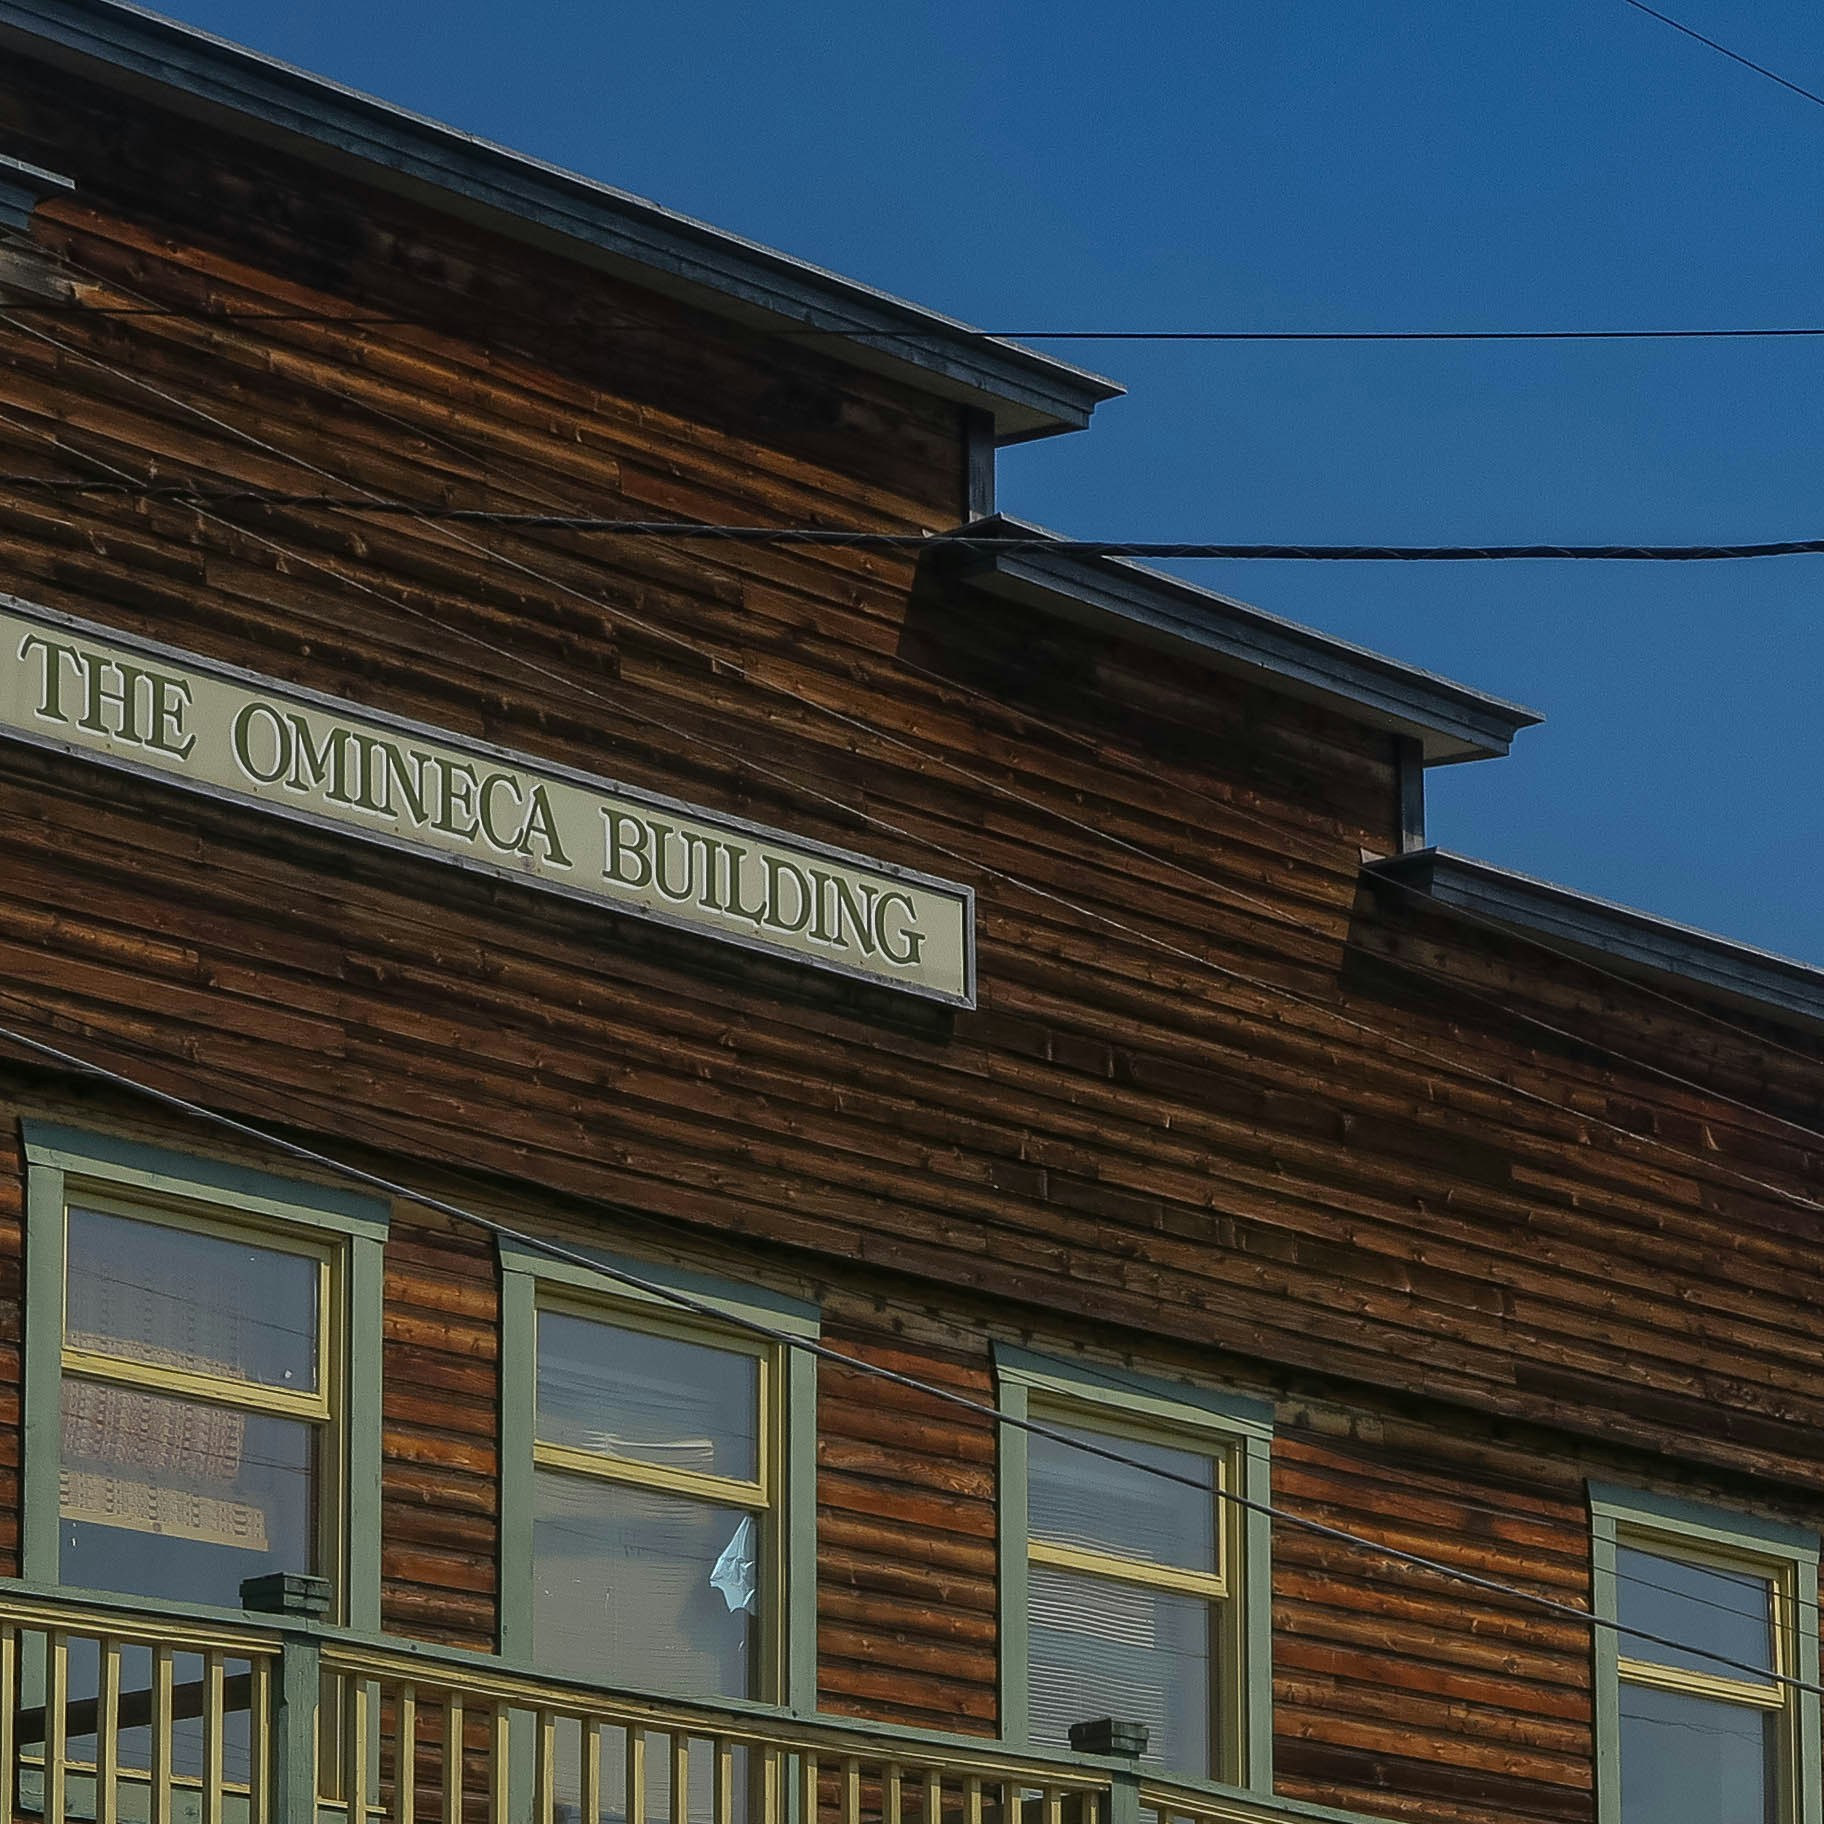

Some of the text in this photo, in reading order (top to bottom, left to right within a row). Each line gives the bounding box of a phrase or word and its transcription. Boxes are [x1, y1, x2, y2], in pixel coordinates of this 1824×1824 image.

[17, 632, 926, 967] THE OMINECA BUILDING
